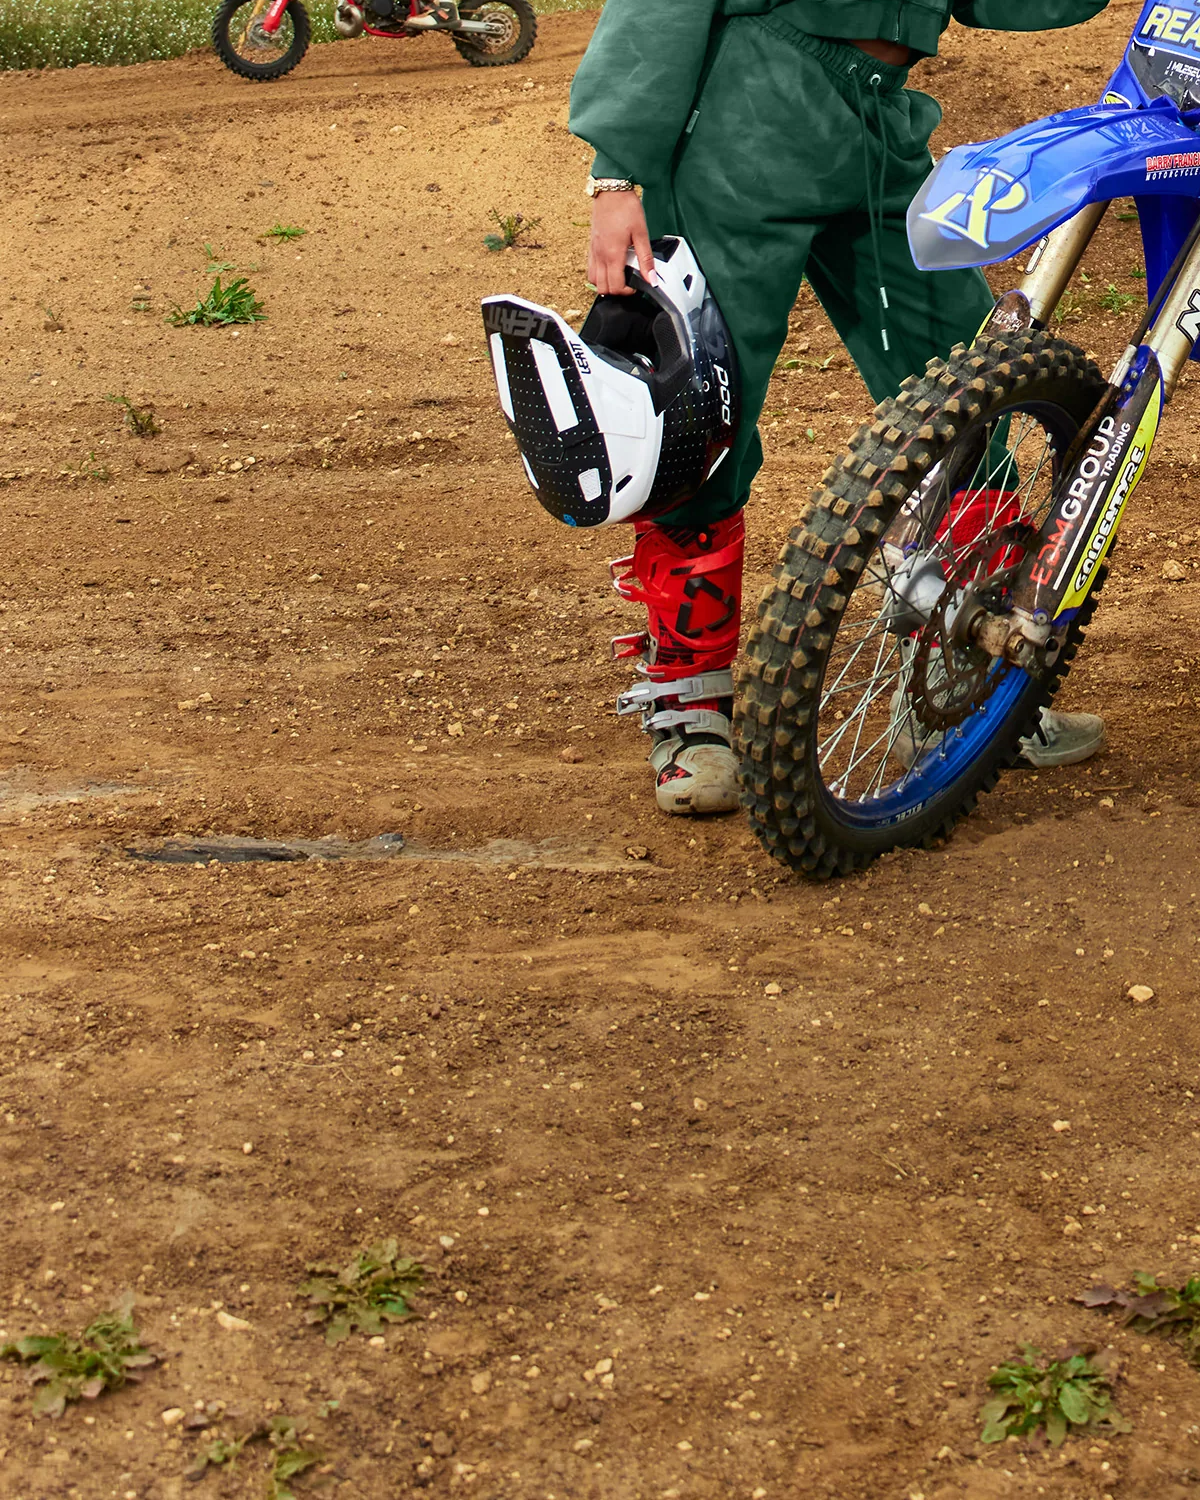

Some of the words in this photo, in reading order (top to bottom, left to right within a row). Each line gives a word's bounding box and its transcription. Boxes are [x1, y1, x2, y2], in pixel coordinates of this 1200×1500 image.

[568, 340, 591, 375] LEATT
[1100, 422, 1131, 477] TRADING
[1074, 443, 1147, 593] GOLDENTYRE
